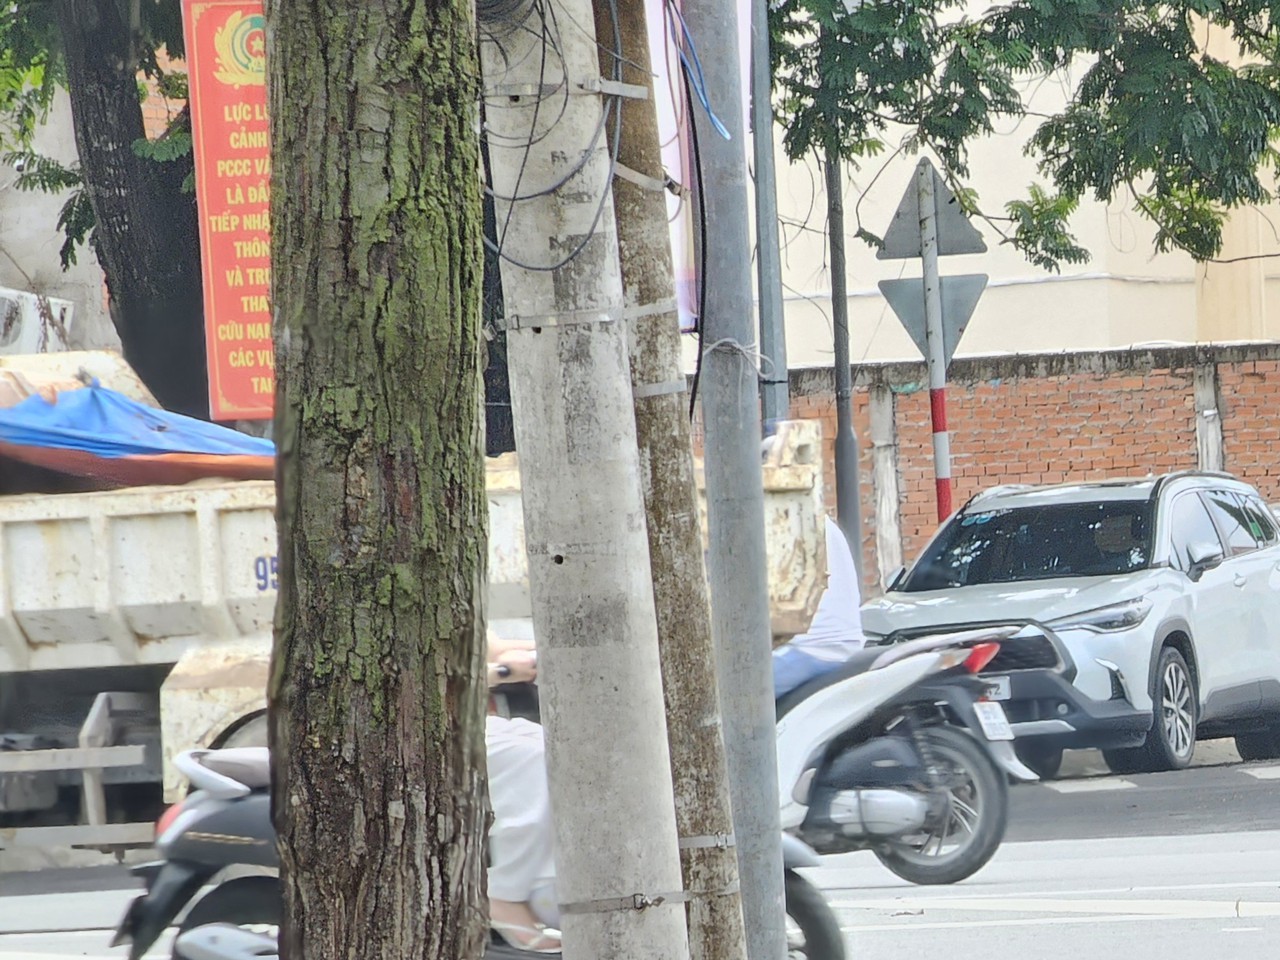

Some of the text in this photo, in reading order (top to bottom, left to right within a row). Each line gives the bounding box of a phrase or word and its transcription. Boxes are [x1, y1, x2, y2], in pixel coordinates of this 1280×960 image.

[224, 102, 251, 124] LỰC
[230, 126, 268, 149] CẢNH
[217, 158, 251, 177] PCCC
[226, 183, 245, 205] LÀ
[209, 209, 240, 232] TIẾP
[225, 265, 244, 288] VÀ
[218, 319, 243, 341] CỨU
[229, 347, 254, 368] CÁC
